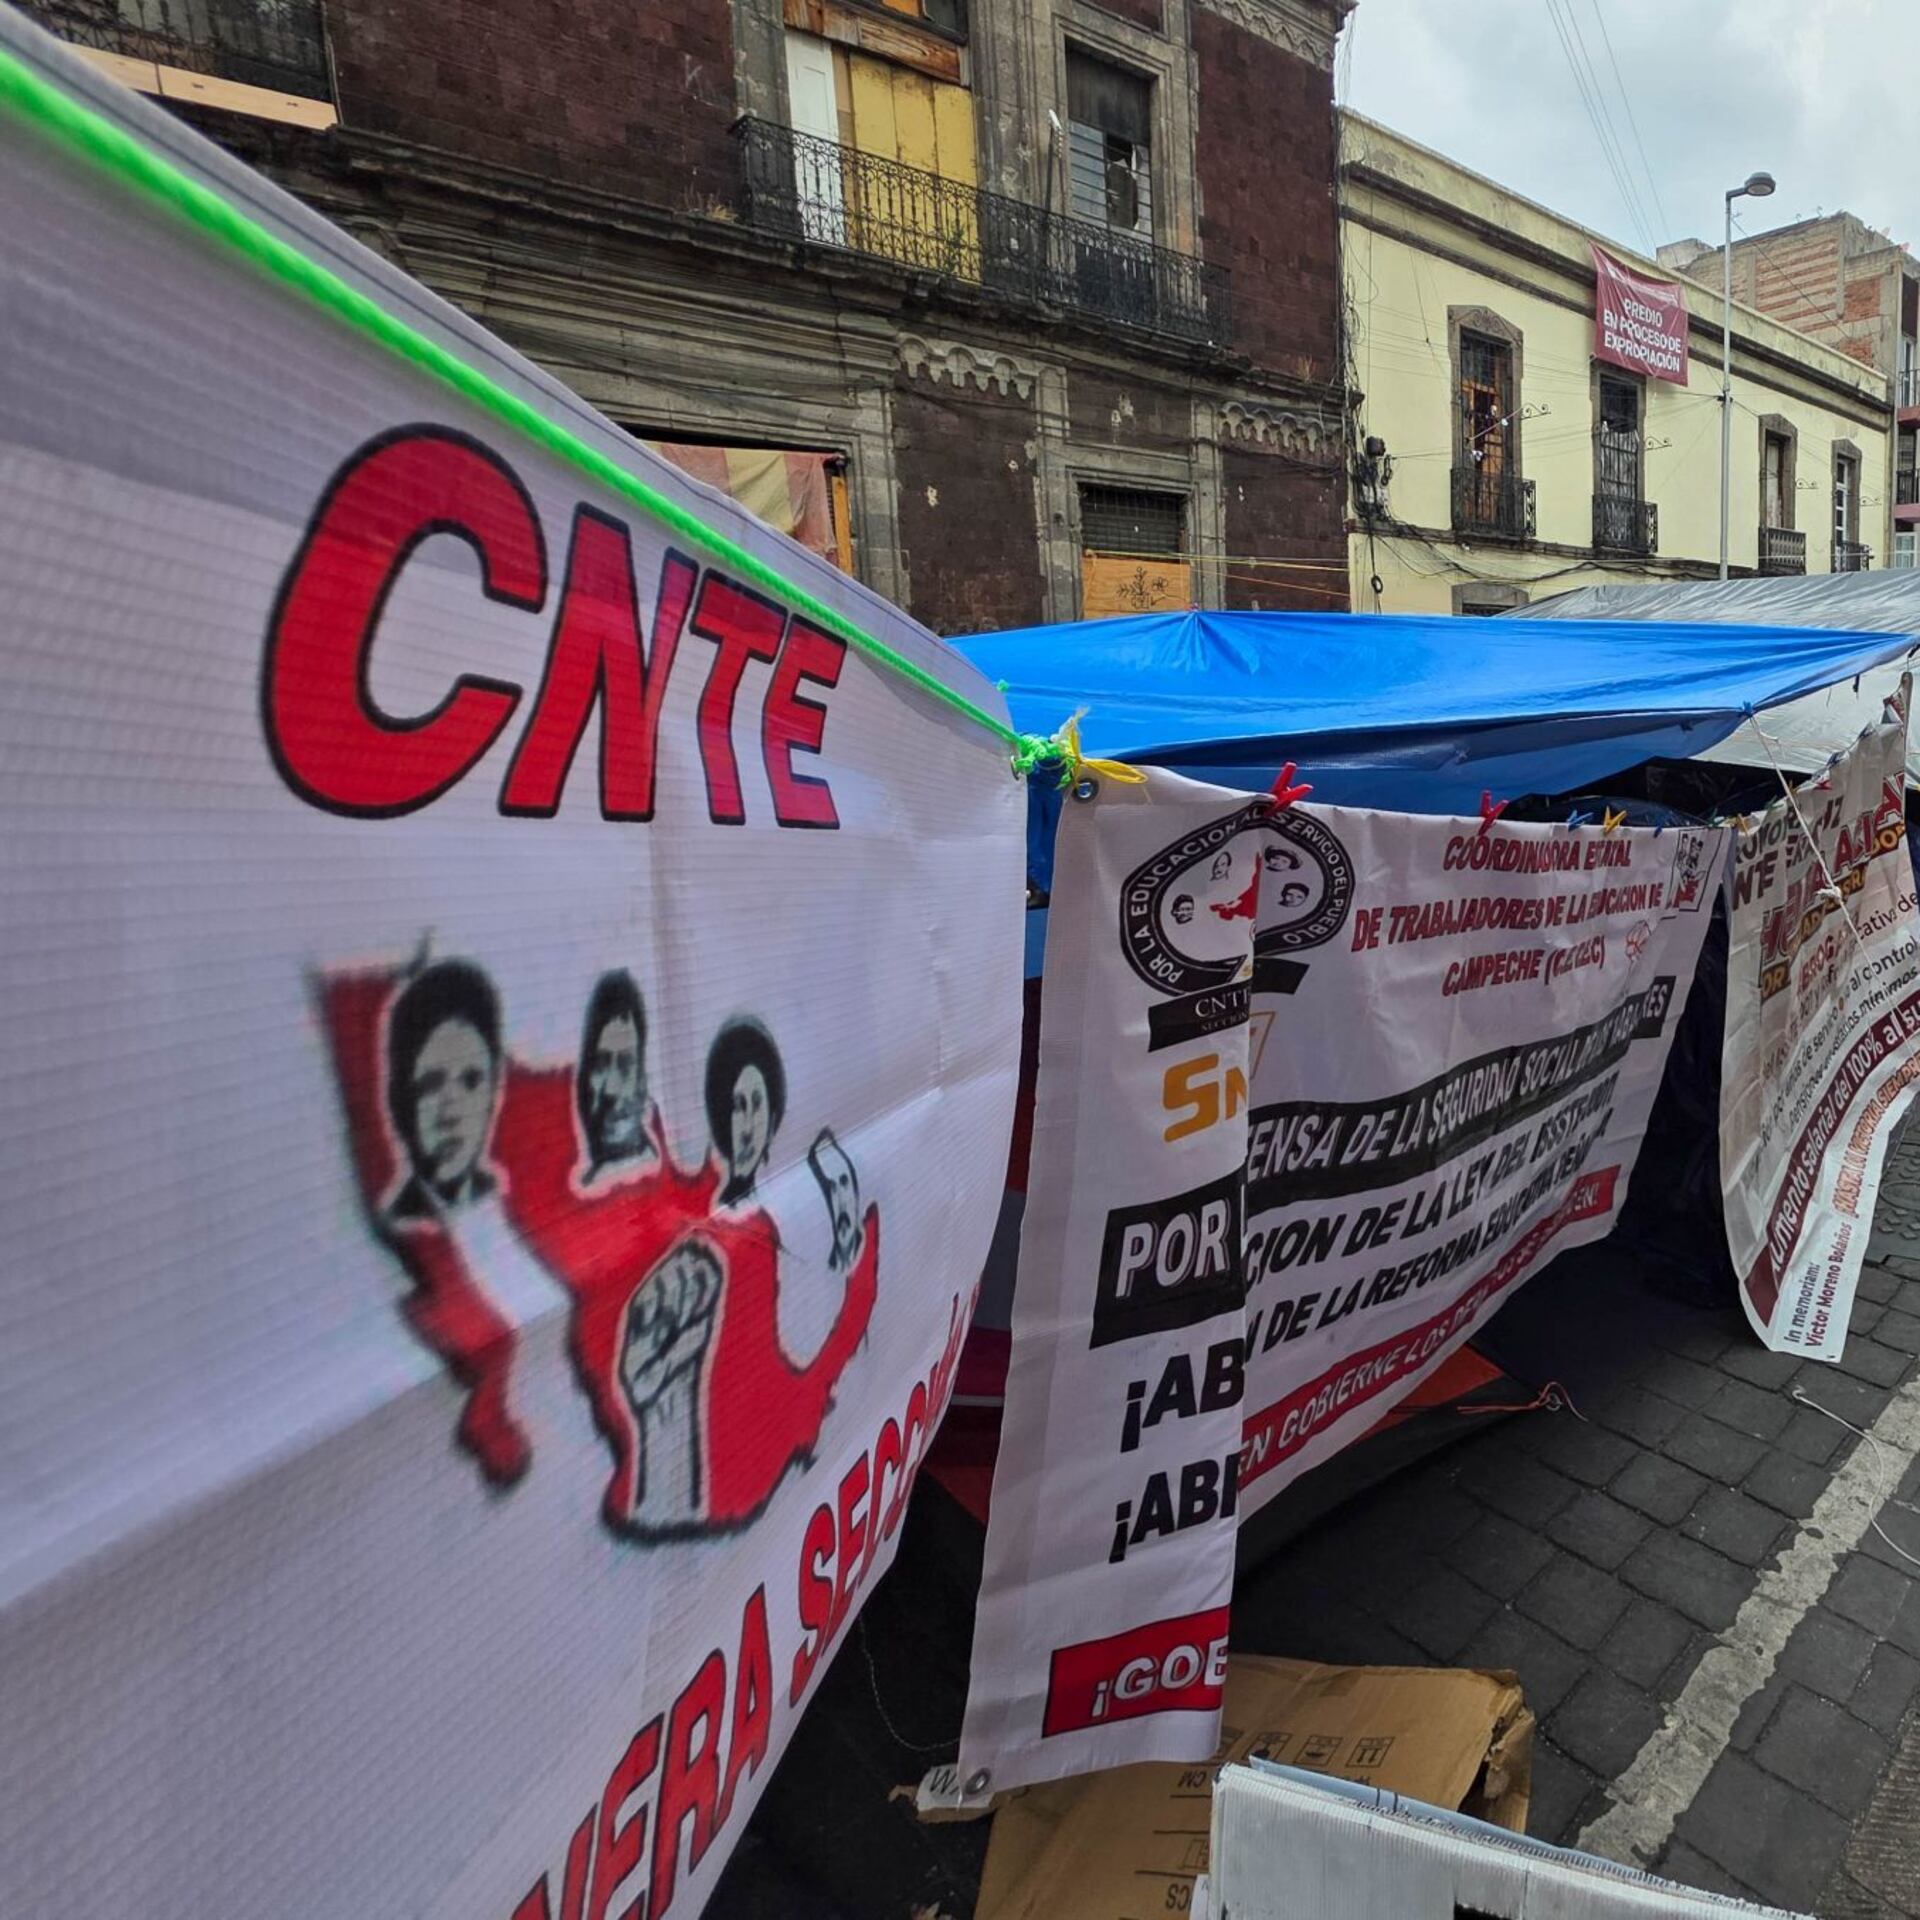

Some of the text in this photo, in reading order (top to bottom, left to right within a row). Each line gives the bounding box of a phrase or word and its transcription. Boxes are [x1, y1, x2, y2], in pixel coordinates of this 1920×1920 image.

[1603, 309, 1682, 353] EN PROCESO DE
[1624, 298, 1662, 327] PREDIO
[1604, 331, 1680, 373] EXPROPIACIÓN
[261, 421, 848, 830] CNTE
[1271, 811, 1339, 866] SERVICIO
[1131, 821, 1237, 917] EDUCACION
[1332, 866, 1347, 890] DEL
[1134, 930, 1151, 955] LA
[1282, 898, 1346, 944] PUEBLO
[1352, 907, 1384, 952] DE
[1388, 896, 1545, 945] TRABAJADORES
[1566, 894, 1588, 924] LA
[1149, 956, 1184, 984] POR
[1442, 948, 1545, 997] CAMPECHE
[1862, 934, 1919, 981] control
[1801, 1093, 1838, 1175] salarial
[1833, 1067, 1854, 1111] del
[1848, 1027, 1885, 1083] 100%
[1882, 1010, 1904, 1046] al
[1115, 1197, 1230, 1299] POR
[1339, 1107, 1397, 1165] DE
[1388, 1097, 1427, 1157] LA
[1427, 1055, 1522, 1145] SEGURIDAD
[1519, 1038, 1580, 1097] SOCIAL
[1341, 1198, 1407, 1257] DE
[1400, 1180, 1447, 1240] LA
[1447, 1150, 1497, 1221] LEY
[1261, 1292, 1322, 1353] DE
[1315, 1277, 1365, 1330] LA
[1360, 1220, 1482, 1310] REFORMA
[1817, 1263, 1843, 1308] Moreno
[1784, 1328, 1800, 1344] In
[1277, 1342, 1410, 1451] GOBIERNE
[1164, 1883, 1192, 1912] CS
